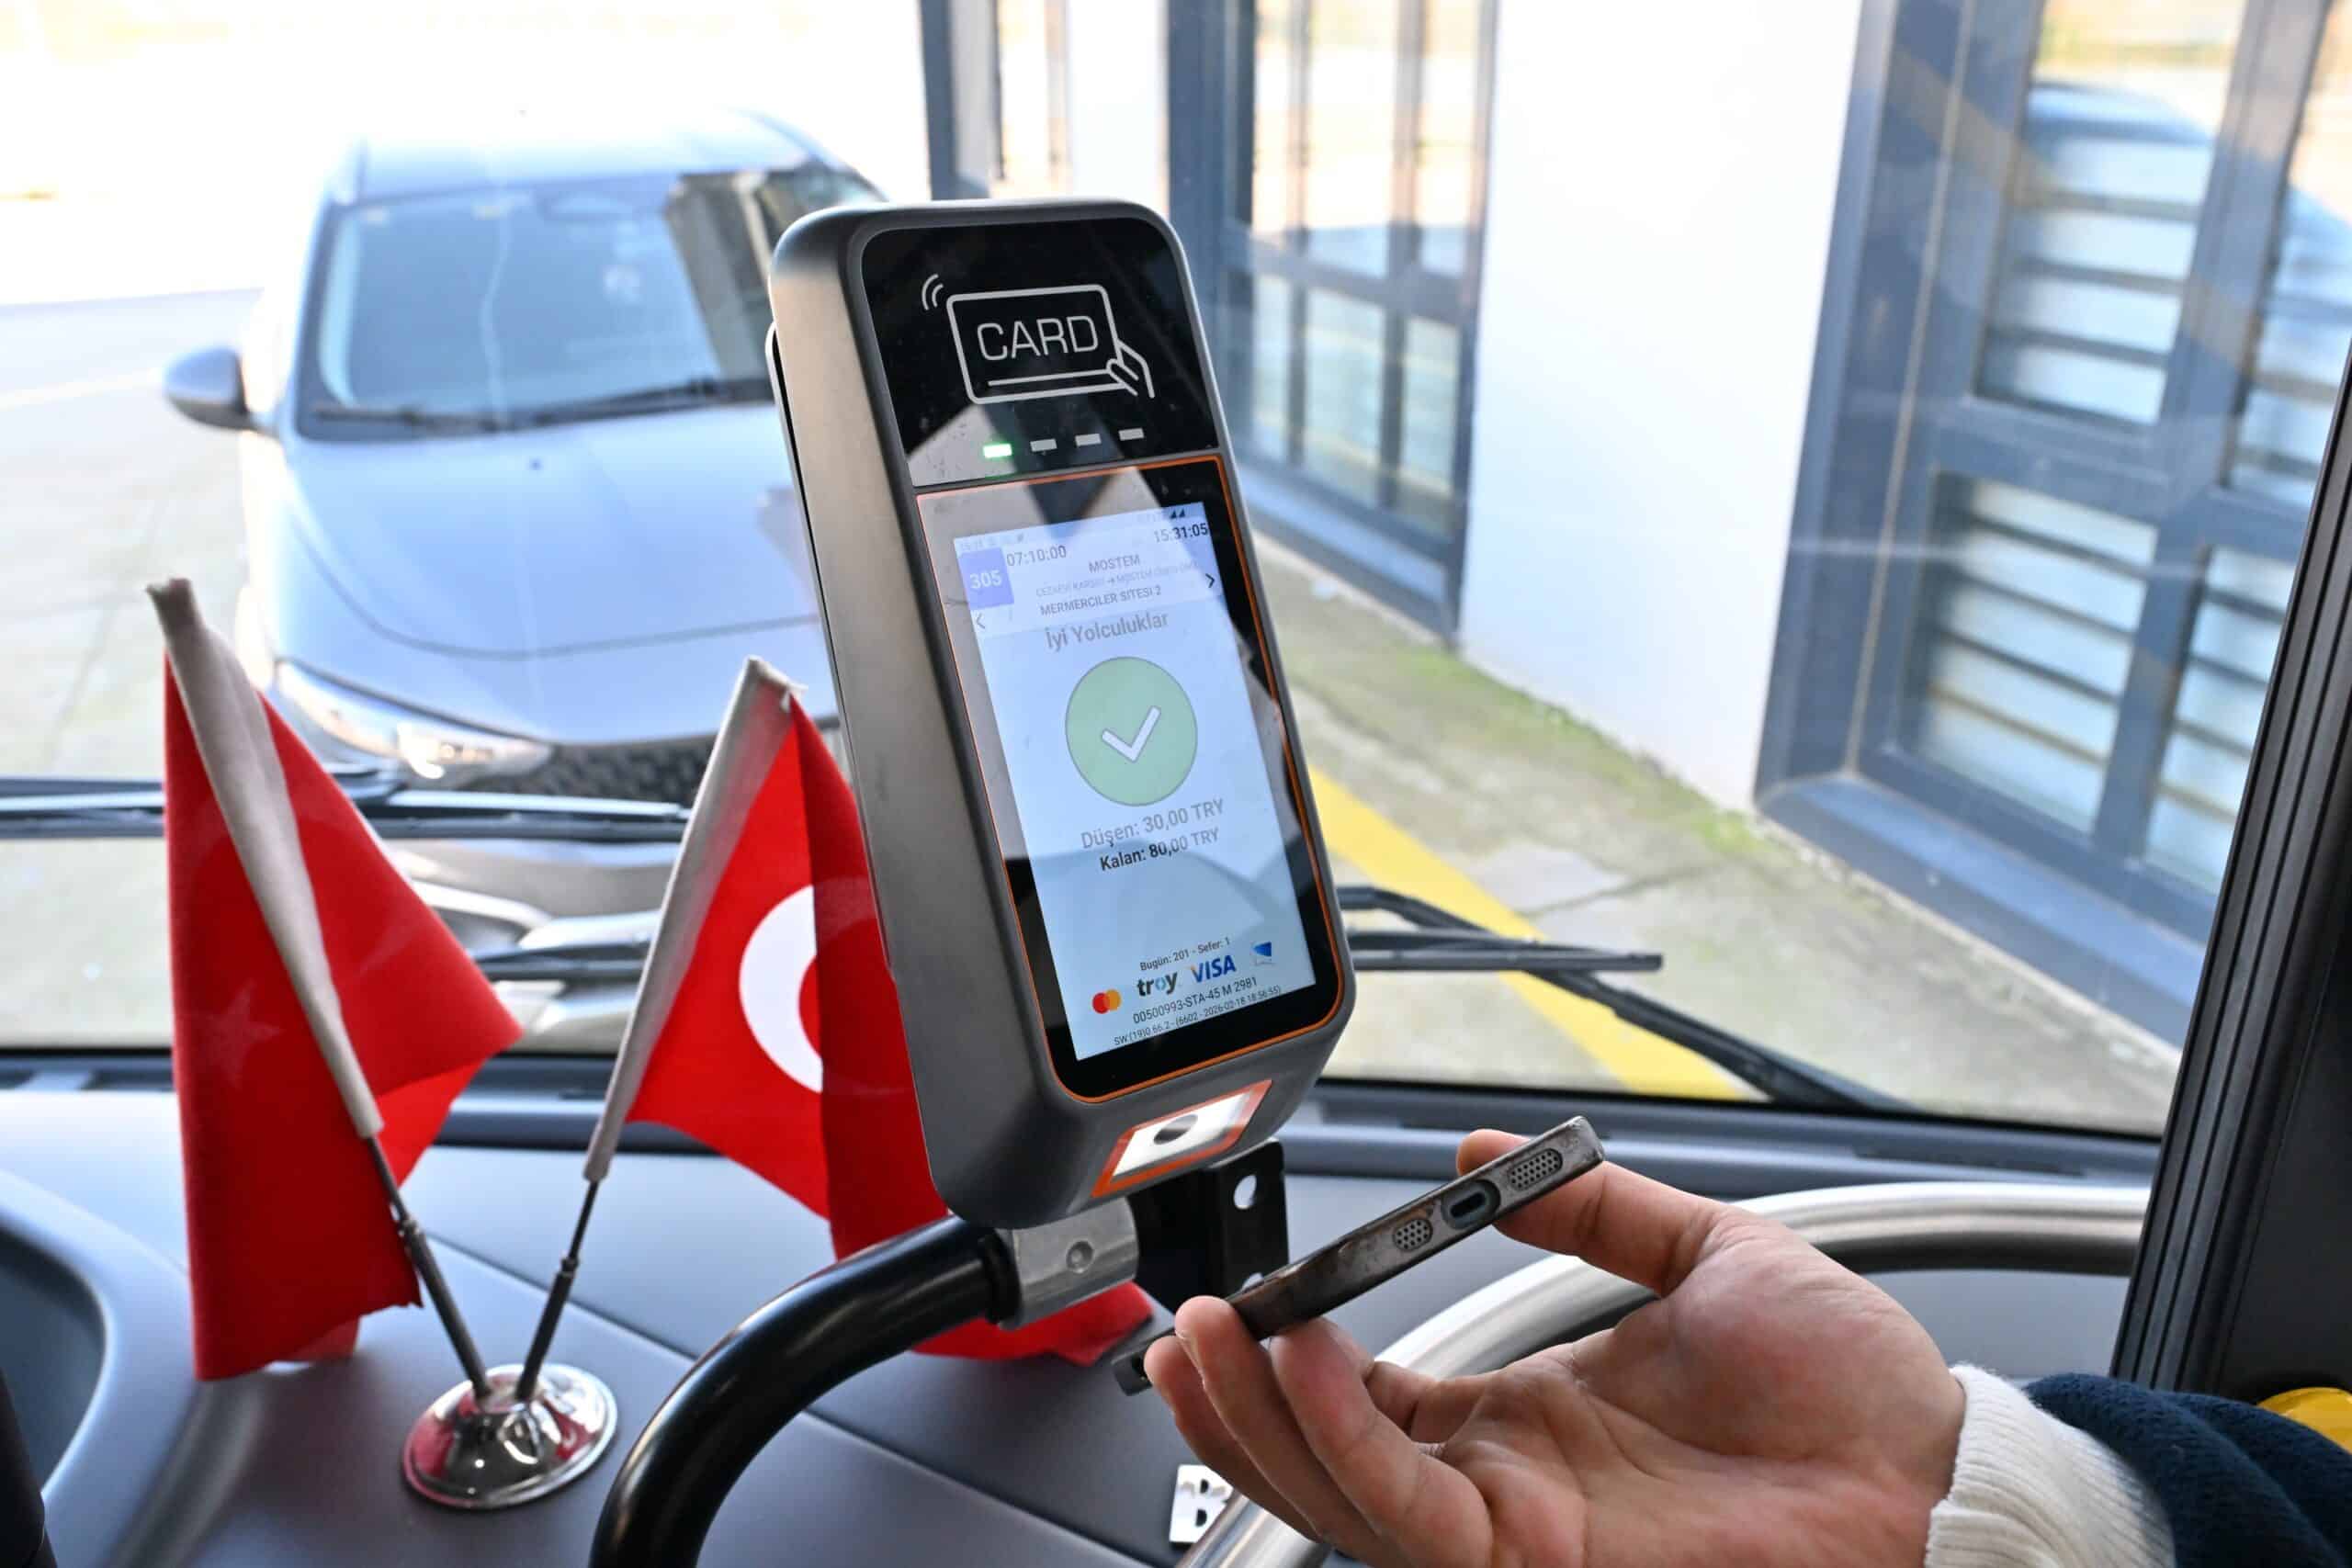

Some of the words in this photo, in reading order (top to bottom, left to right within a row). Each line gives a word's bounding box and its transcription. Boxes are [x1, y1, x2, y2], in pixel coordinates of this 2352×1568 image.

[977, 315, 1099, 361] CARD
[1154, 523, 1209, 544] 15:31:05
[1006, 545, 1067, 567] 07:10:00
[1088, 555, 1140, 574] MOSTEM
[969, 570, 1002, 590] 305
[1155, 585, 1161, 597] 2
[1072, 612, 1169, 643] Yolculuklar
[1080, 822, 1139, 849] Düşen:
[1142, 808, 1188, 833] 30,00
[1191, 798, 1224, 821] TRY
[1100, 849, 1146, 872] Kalan:
[1148, 836, 1188, 859] 80,00
[1191, 827, 1220, 846] TRY
[1140, 956, 1170, 972] Bugün:
[1173, 949, 1190, 963] 201
[1197, 940, 1223, 954] Sefer:
[1225, 937, 1230, 946] 1
[1136, 972, 1178, 997] troy
[1191, 954, 1236, 983] VISA
[1222, 984, 1232, 996] M
[1234, 976, 1257, 993] 2981
